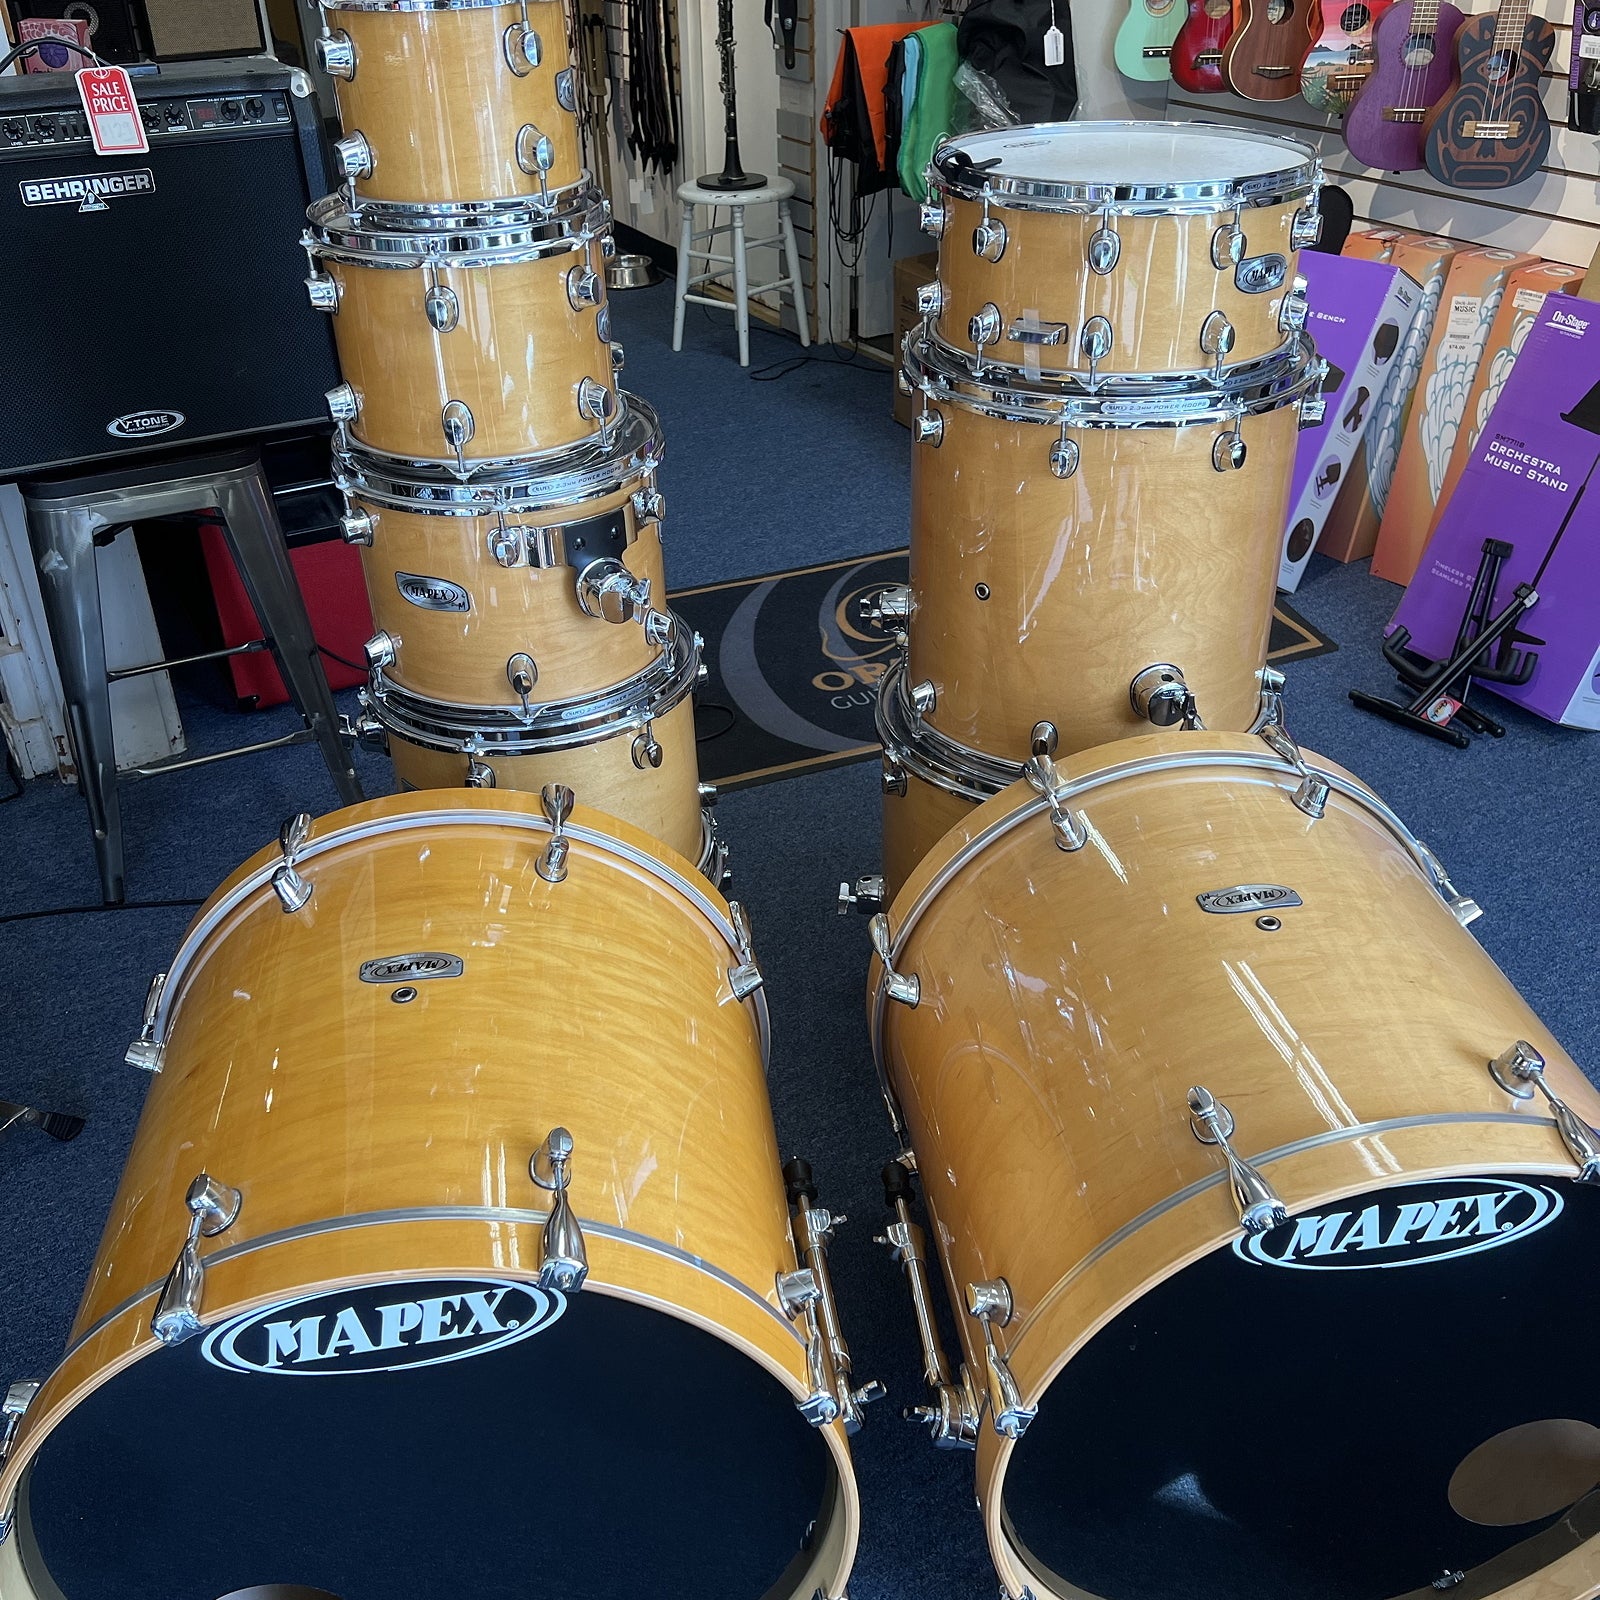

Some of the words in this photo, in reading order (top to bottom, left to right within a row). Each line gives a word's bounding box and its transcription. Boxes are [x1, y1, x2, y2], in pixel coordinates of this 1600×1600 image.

[91, 81, 121, 96] SALE
[92, 96, 129, 113] PRICE
[24, 174, 151, 202] BEHRINGER
[1454, 304, 1477, 313] MUSIC
[1316, 312, 1346, 324] BENCH
[1552, 310, 1589, 330] On-Stage
[1153, 403, 1179, 411] POWER
[1181, 401, 1207, 409] HOOPS
[116, 415, 168, 430] V-TONE
[1489, 441, 1561, 476] ORCHESTRA
[578, 474, 601, 484] POWER
[1483, 452, 1523, 475] MUSIC
[1526, 469, 1569, 492] STAND
[410, 586, 448, 601] MAPEX
[830, 690, 877, 709] GUI
[1225, 889, 1276, 906] MAPEX
[386, 960, 440, 975] MAPEX
